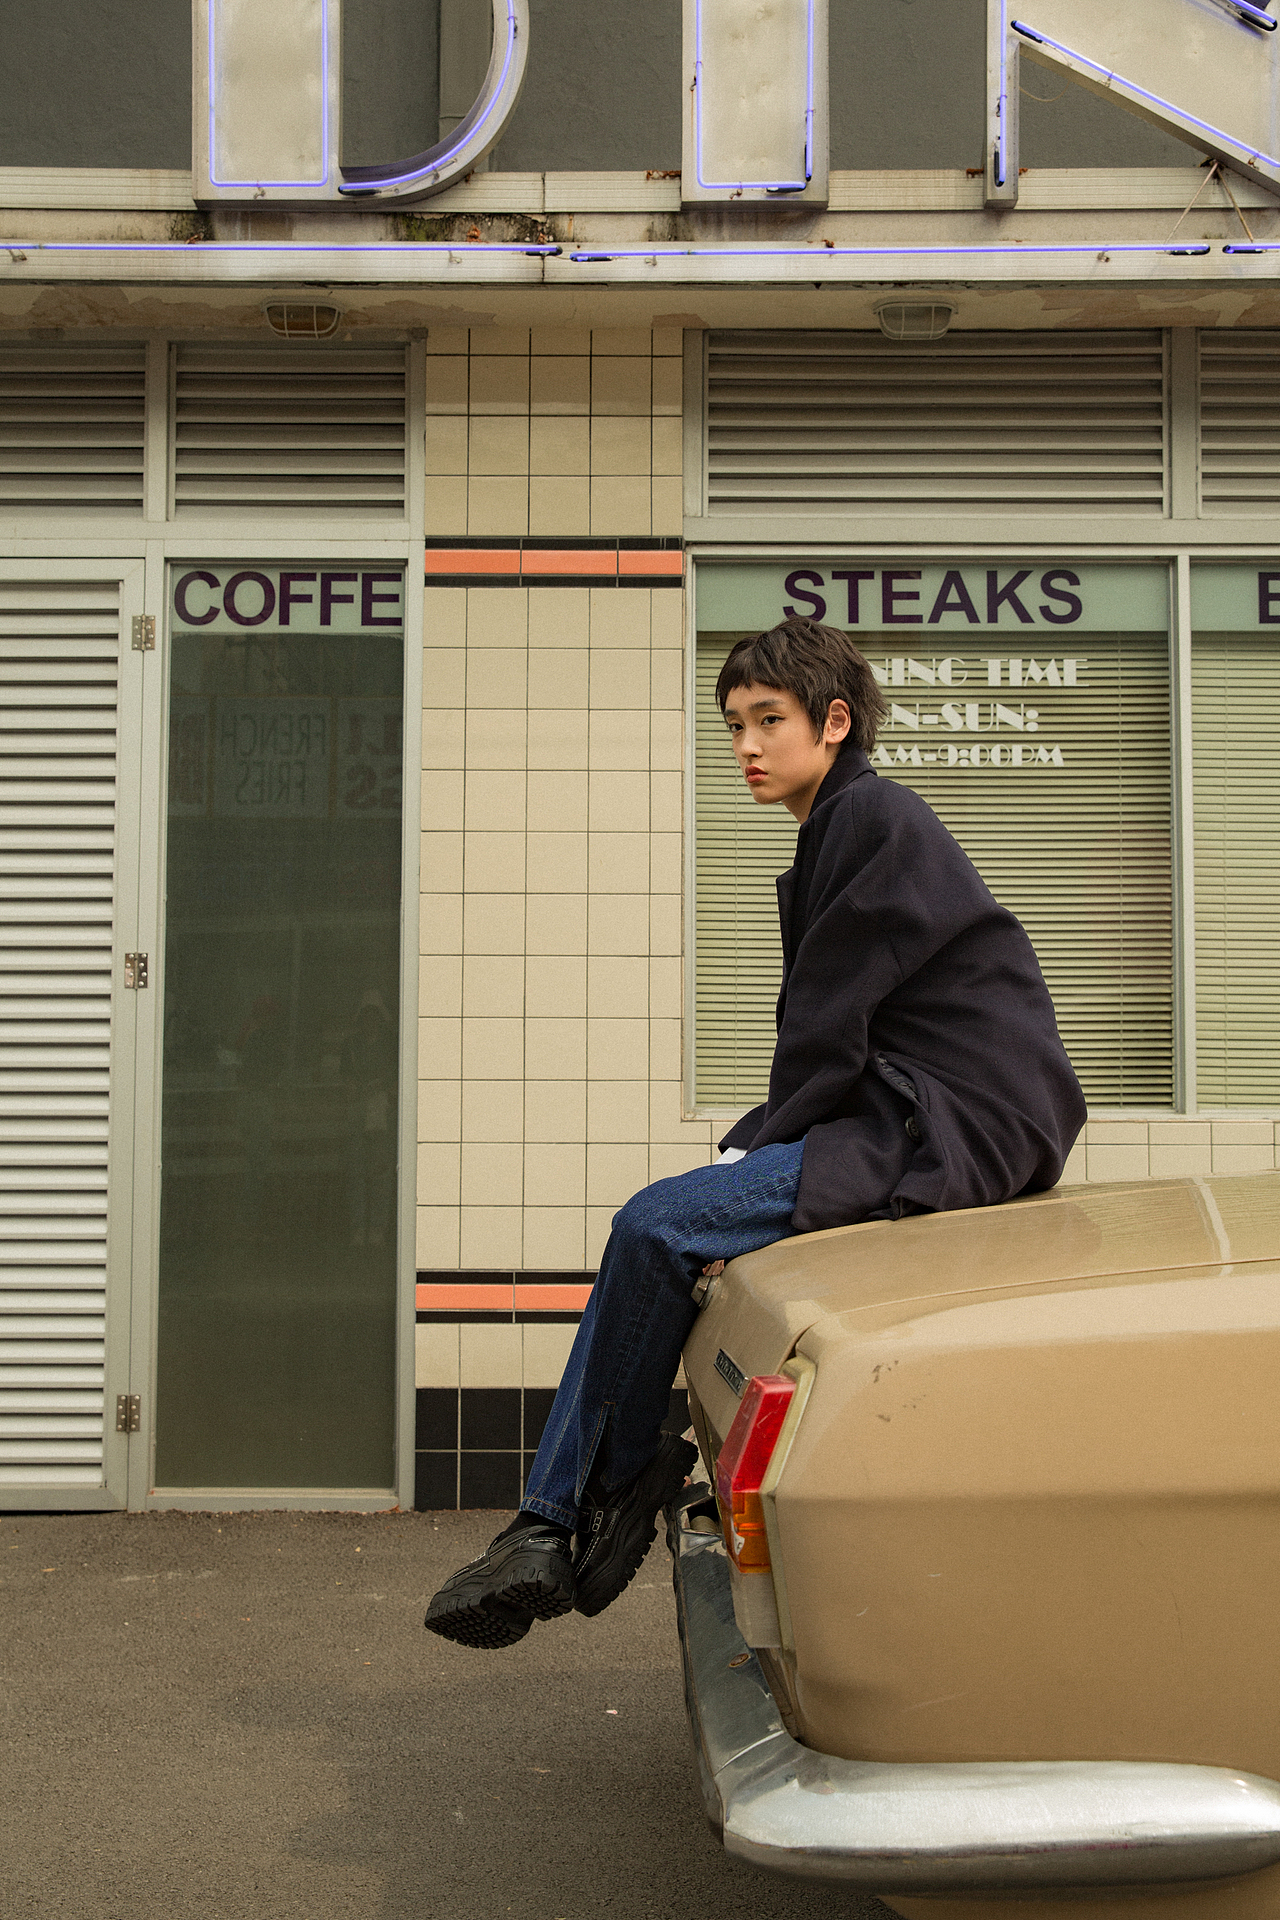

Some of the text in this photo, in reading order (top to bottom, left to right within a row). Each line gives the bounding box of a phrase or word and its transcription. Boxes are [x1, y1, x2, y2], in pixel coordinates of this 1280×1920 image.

[174, 570, 402, 626] COFFE
[783, 569, 1083, 625] STEAKS
[980, 658, 1089, 687] TIME
[879, 703, 1039, 732] N-SUN:
